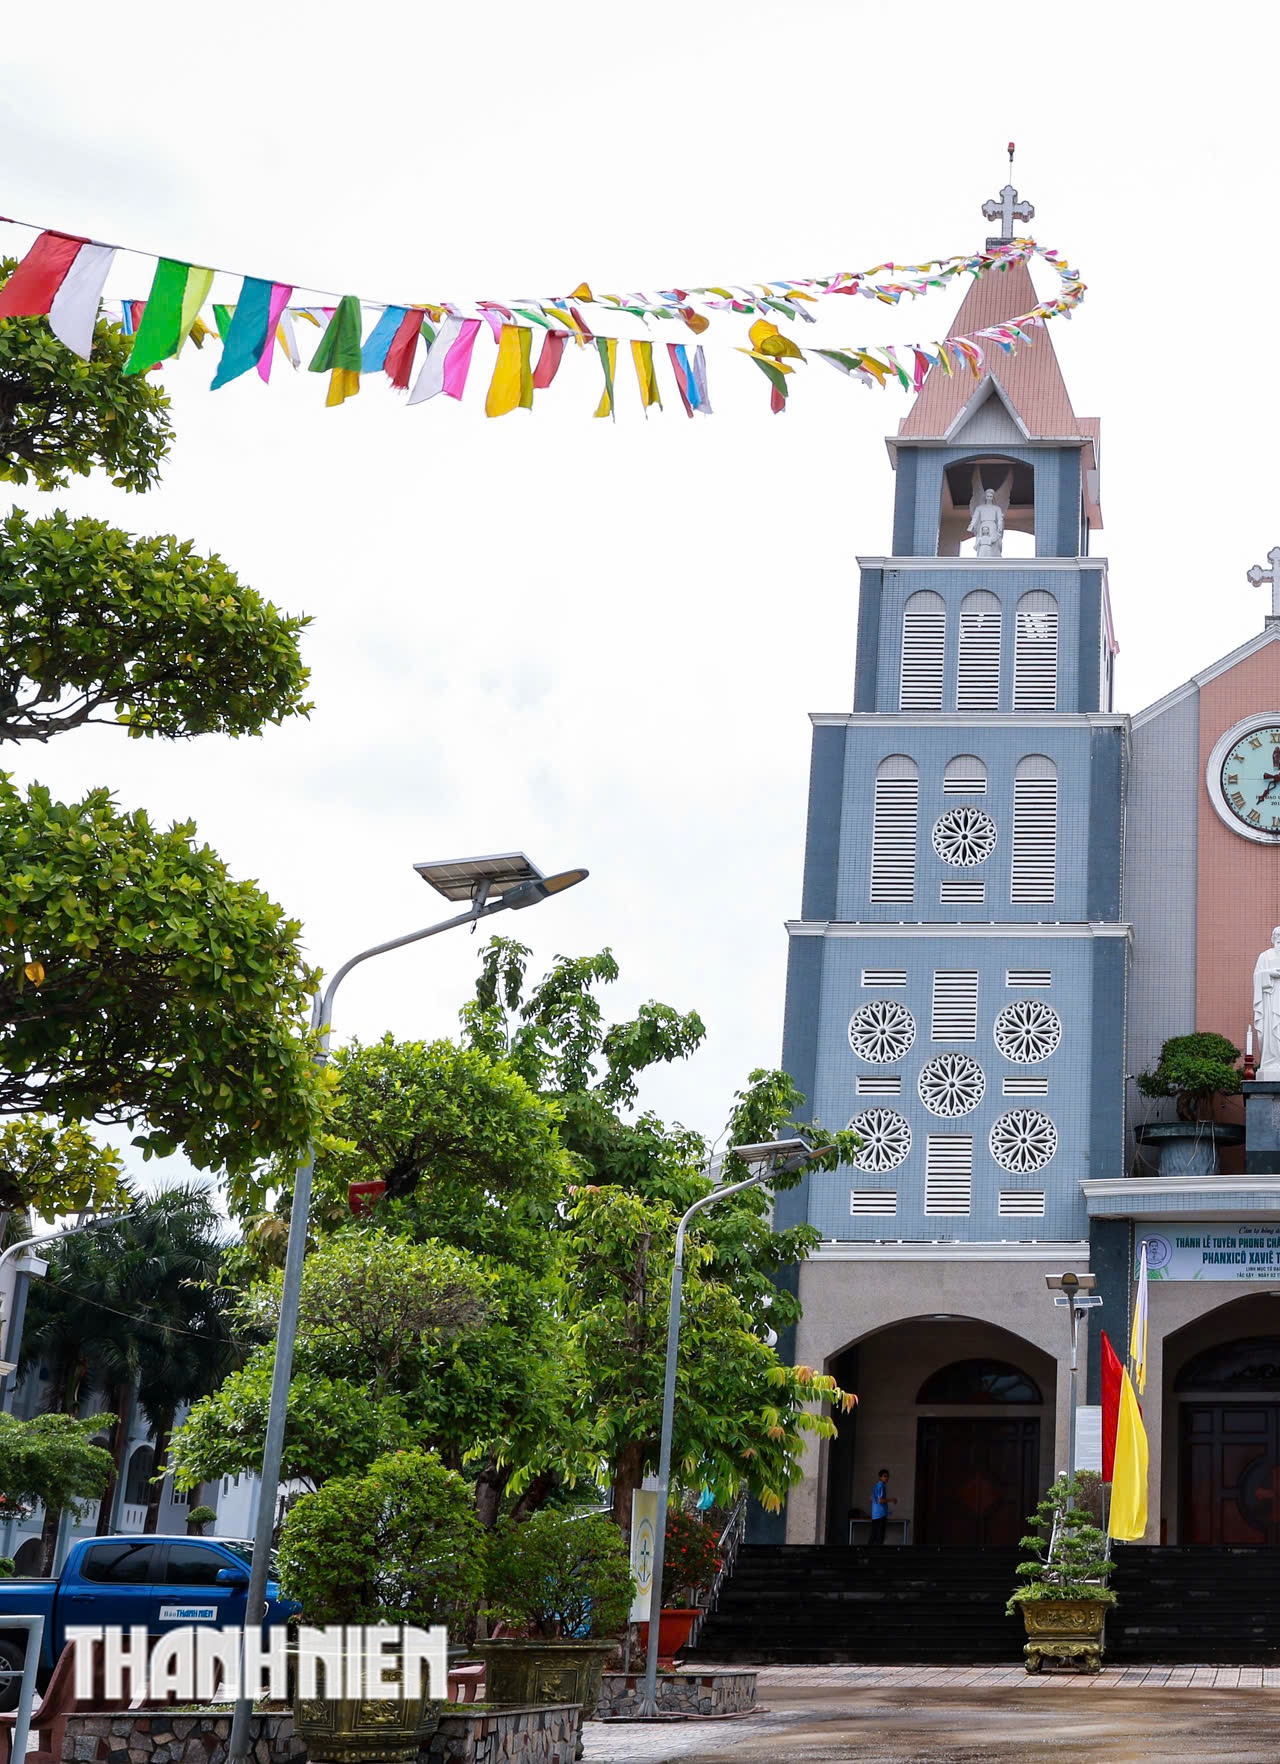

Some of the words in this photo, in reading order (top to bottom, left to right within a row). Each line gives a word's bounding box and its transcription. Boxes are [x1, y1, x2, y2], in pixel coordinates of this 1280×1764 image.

[1176, 1235, 1200, 1248] THÁNH
[1239, 1237, 1264, 1248] PHONG
[1202, 1249, 1246, 1264] PHANXICÔ
[1249, 1249, 1274, 1264] XAVIÊ
